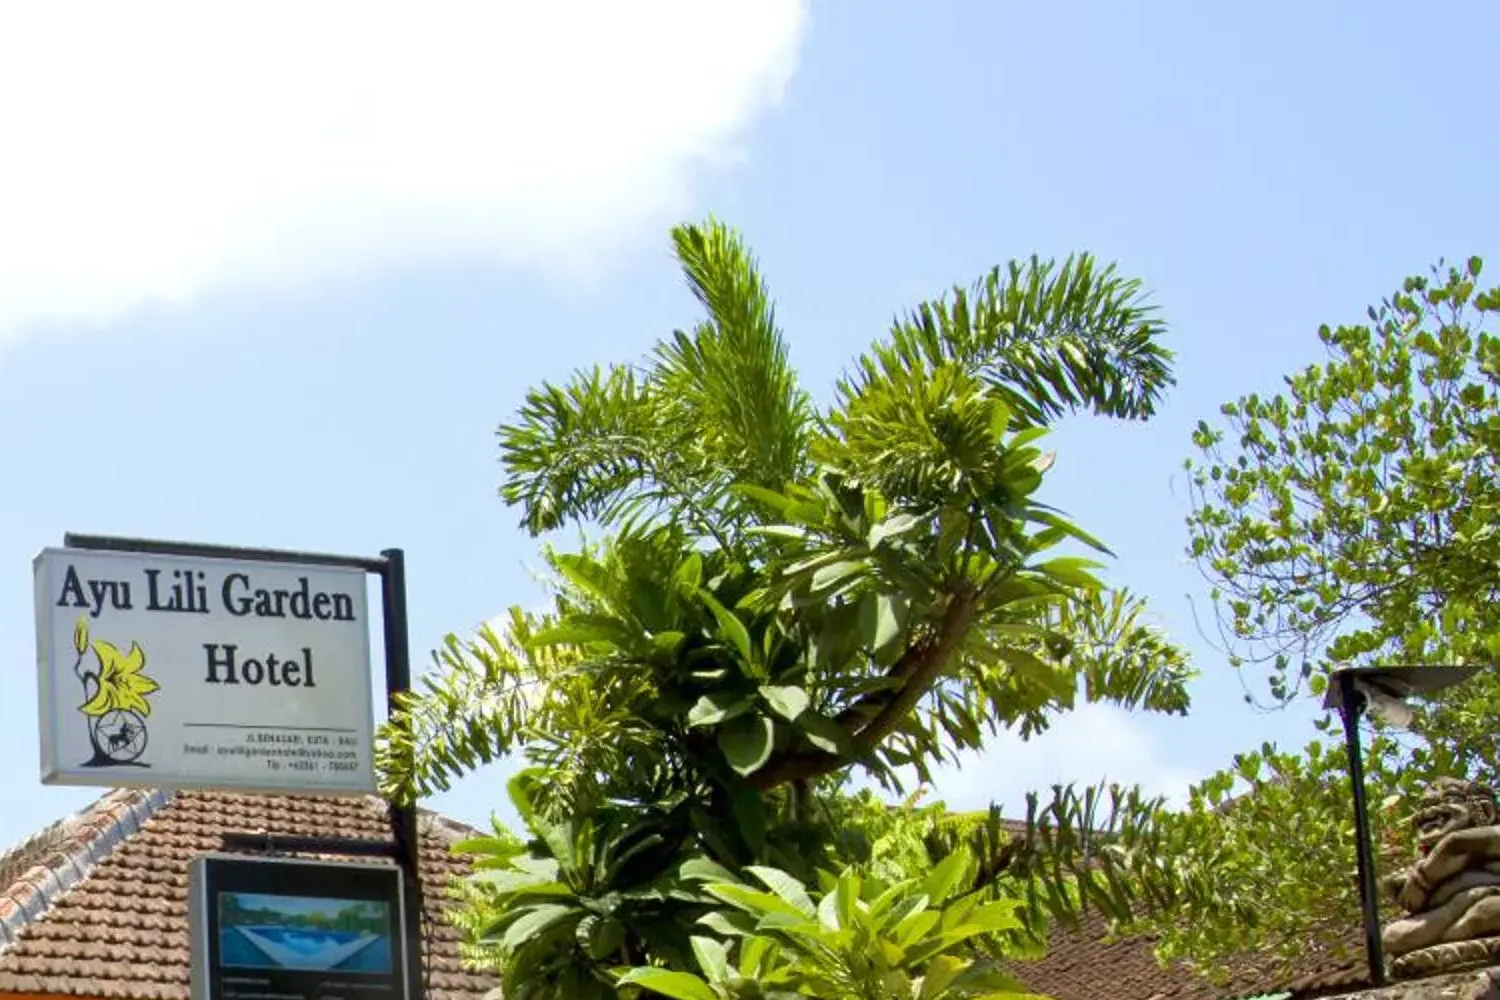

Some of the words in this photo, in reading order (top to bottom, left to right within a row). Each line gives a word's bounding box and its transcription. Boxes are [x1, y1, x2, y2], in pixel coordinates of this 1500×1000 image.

[56, 565, 133, 617] Ayu
[144, 568, 210, 614] Lili
[221, 573, 356, 621] Garden
[203, 644, 316, 688] Hotel
